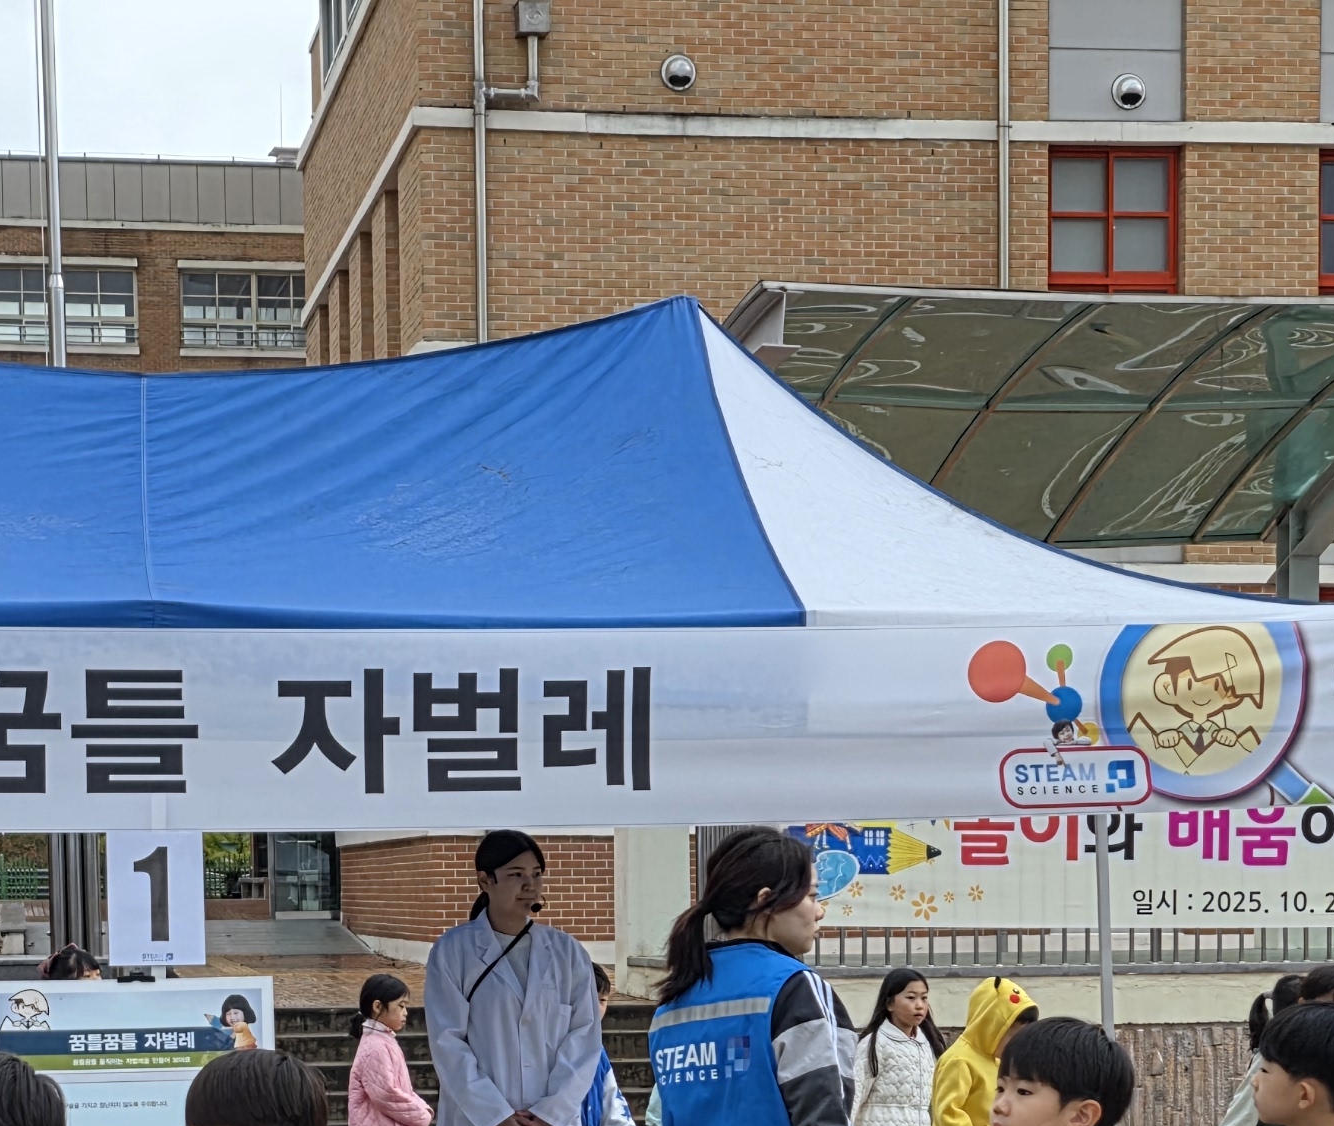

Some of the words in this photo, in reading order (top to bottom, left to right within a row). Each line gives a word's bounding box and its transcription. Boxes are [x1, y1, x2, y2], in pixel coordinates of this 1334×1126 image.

[271, 666, 652, 795] 자벌레
[1014, 762, 1097, 784] STEAM
[1017, 784, 1099, 796] SCIENCE
[133, 846, 170, 942] 1
[1133, 888, 1178, 915] 일시
[1201, 890, 1269, 914] 2025.
[1280, 890, 1315, 914] 10.
[68, 1032, 138, 1052] 꿈틀꿈틀
[144, 1031, 195, 1050] 자벌레
[655, 1041, 717, 1074] STEAM
